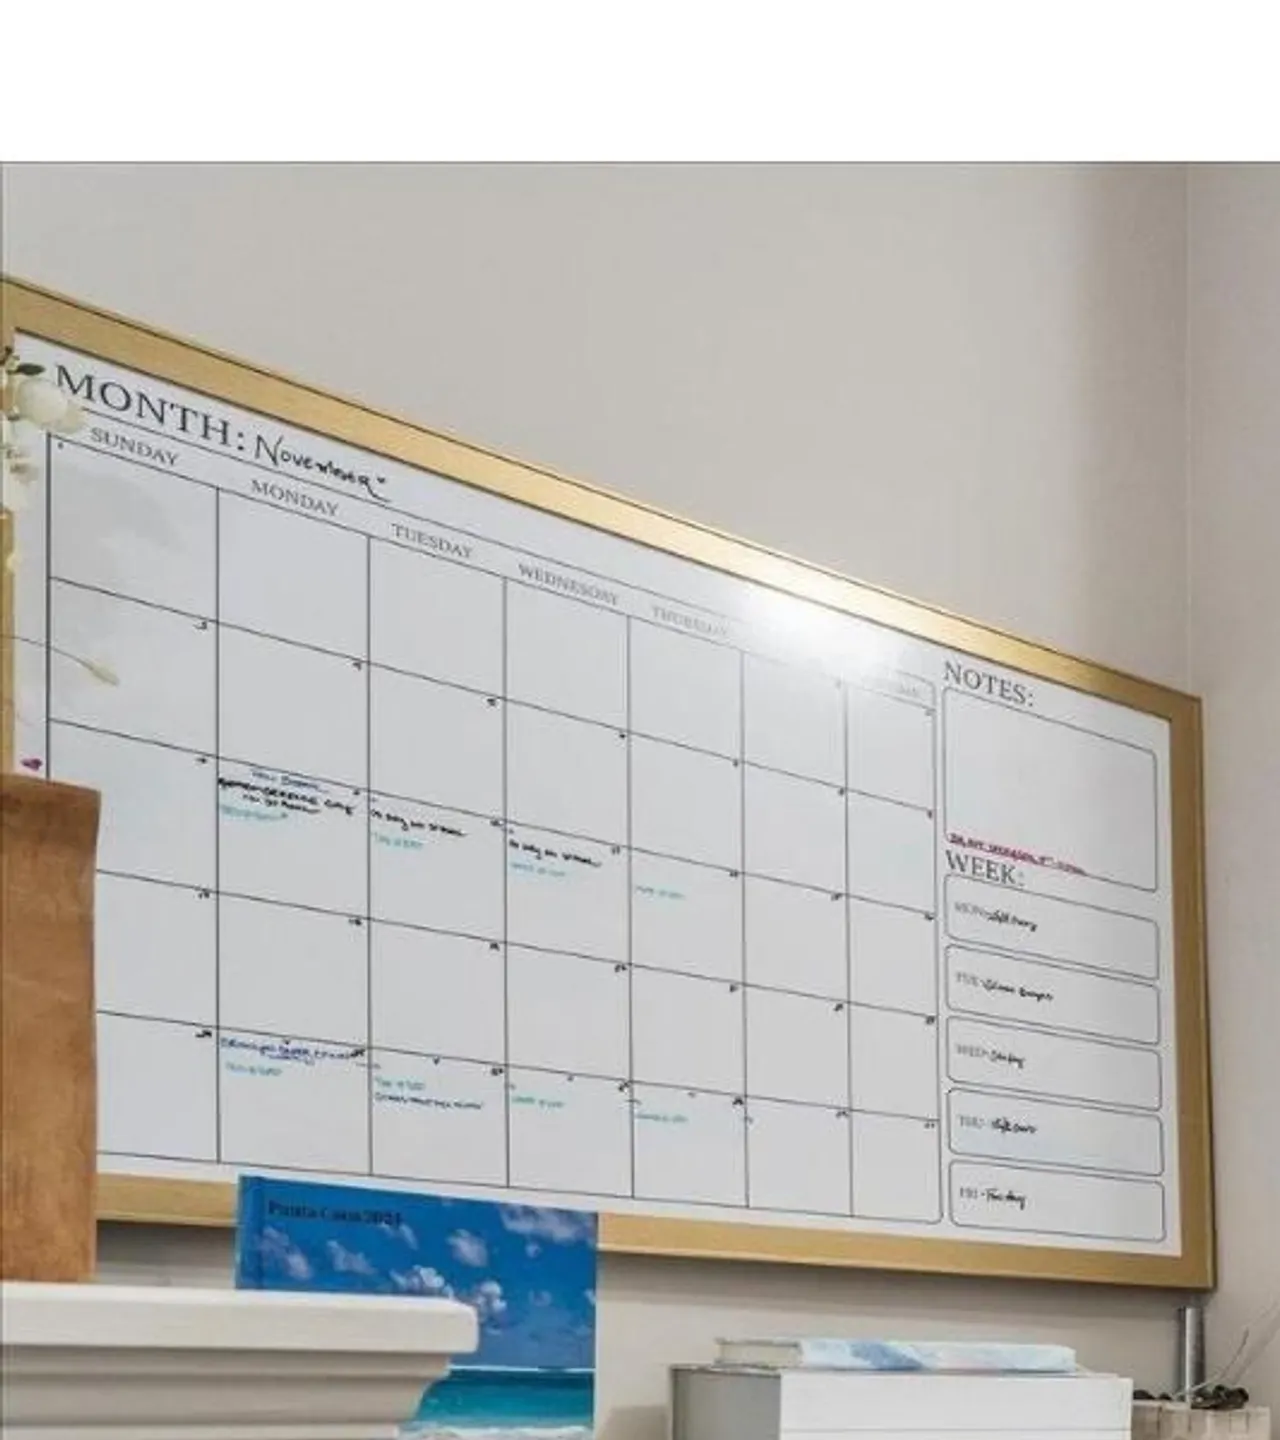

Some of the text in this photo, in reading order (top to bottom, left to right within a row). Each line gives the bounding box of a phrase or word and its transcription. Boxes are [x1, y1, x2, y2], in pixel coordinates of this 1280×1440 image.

[55, 364, 246, 450] MONTH:
[90, 426, 180, 467] SUNDAY
[251, 479, 339, 517] MONDAY
[390, 522, 474, 559] TUESDAY
[517, 563, 620, 606] WEDNESDAY
[943, 660, 1035, 707] NOTES:
[945, 849, 1025, 887] WEEK:
